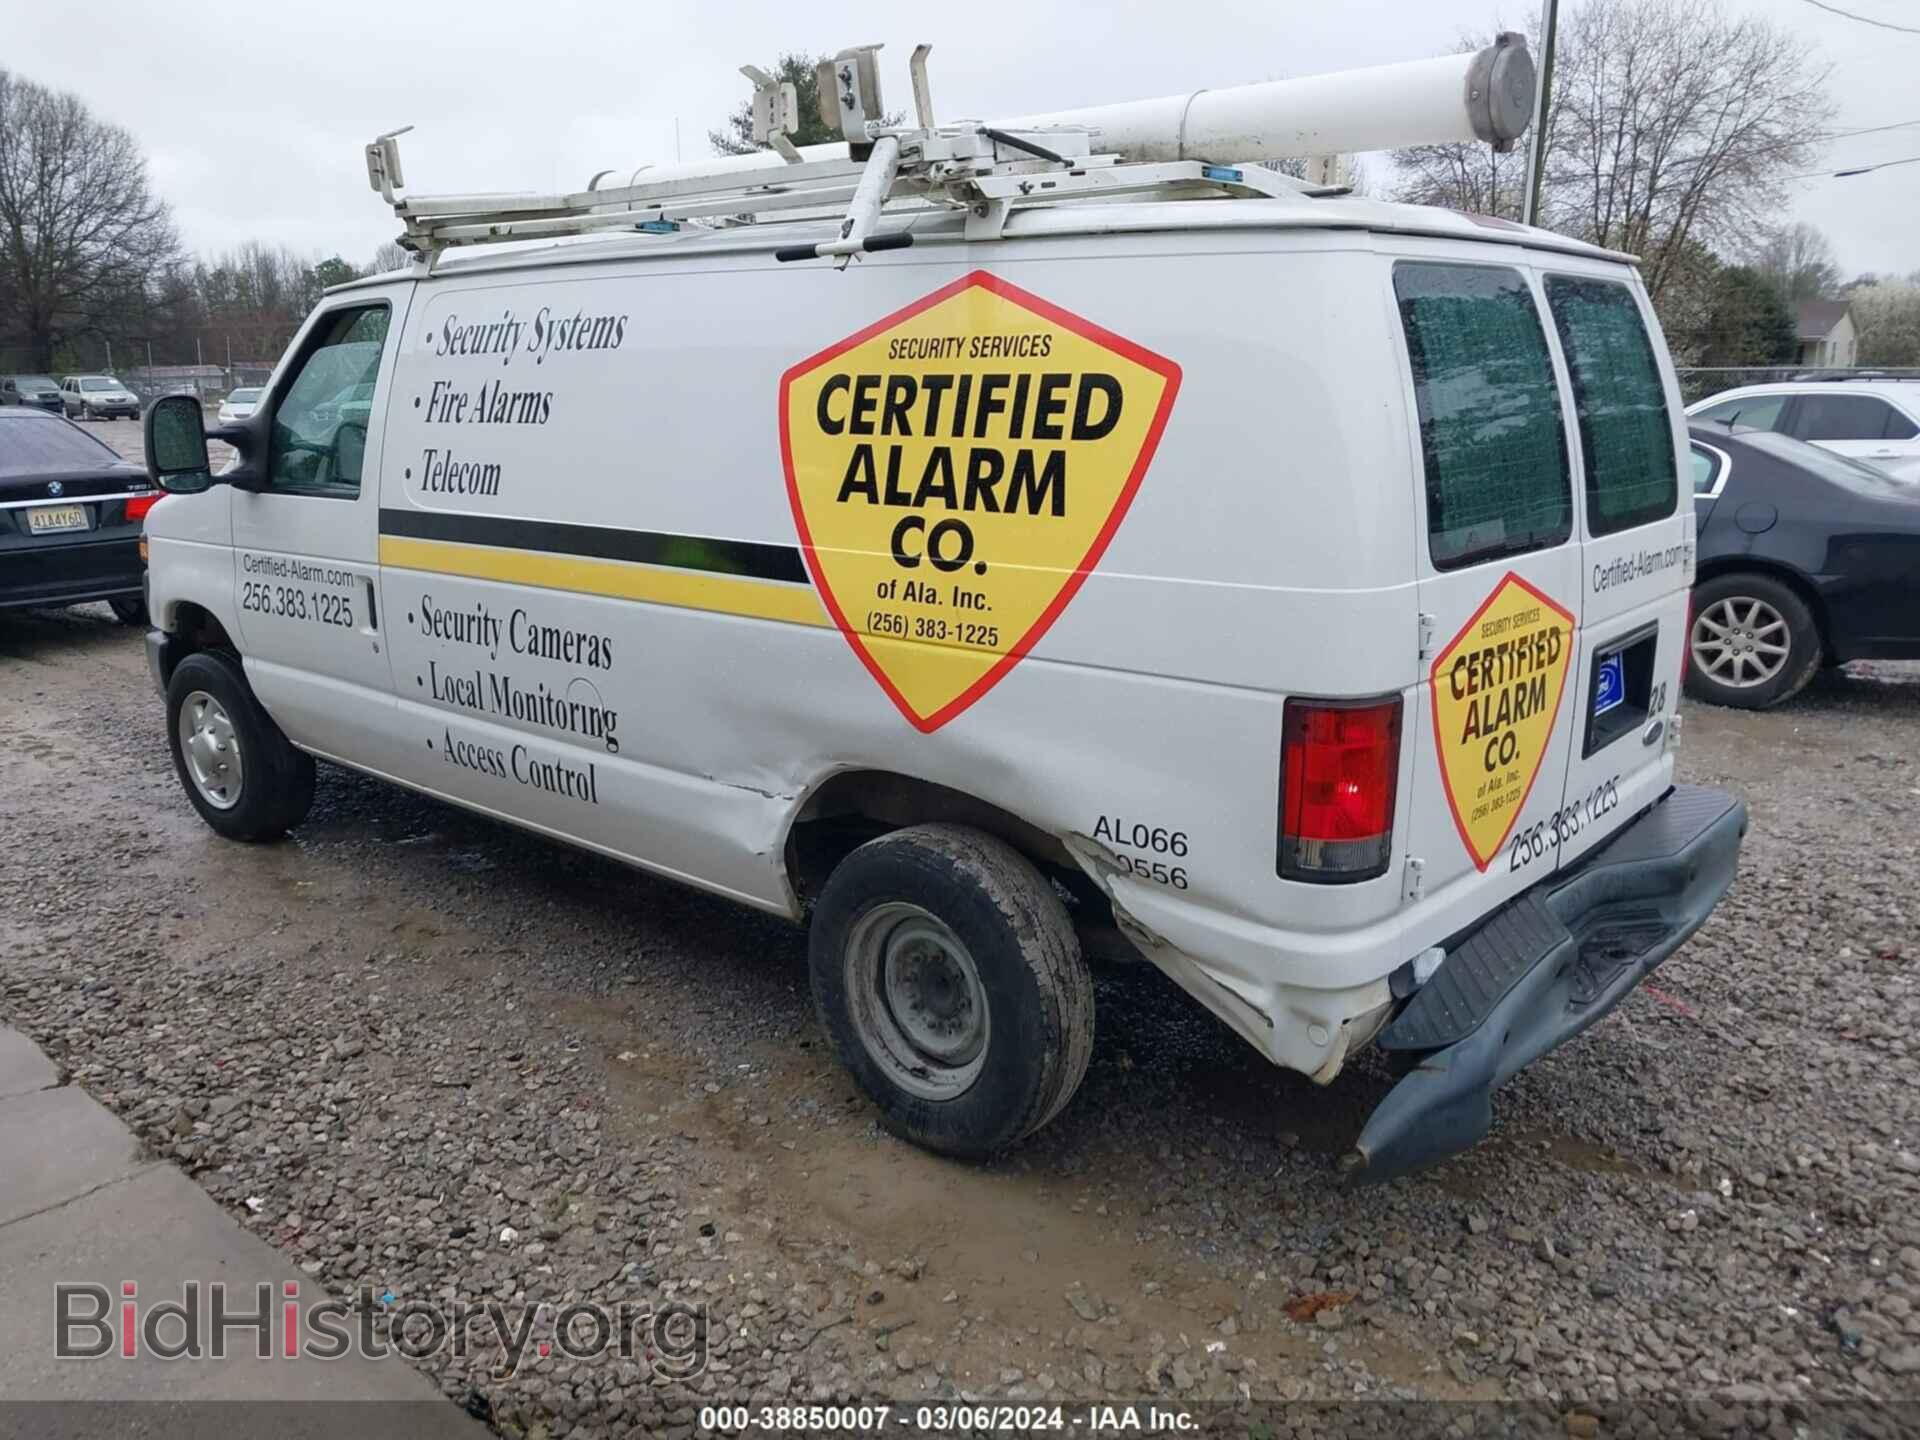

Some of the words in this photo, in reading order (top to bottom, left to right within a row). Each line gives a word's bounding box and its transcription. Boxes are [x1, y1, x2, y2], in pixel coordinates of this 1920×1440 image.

[436, 310, 527, 366] Security
[527, 307, 628, 365] Systems
[888, 337, 966, 359] SECURITY
[969, 334, 1052, 358] SERVICES
[424, 380, 468, 423] Fire
[468, 379, 553, 424] Alarms
[817, 373, 1124, 441] CERTIFIED
[421, 448, 501, 496] Telecom
[836, 444, 1066, 517] ALARM
[243, 553, 354, 588] Certified-Alarm.com
[891, 515, 988, 576] CO.
[242, 581, 353, 628] 256.383.1225
[877, 579, 897, 600] of
[903, 580, 943, 606] Ala.
[952, 586, 993, 612] Inc.
[421, 594, 502, 661] Security
[509, 608, 613, 670] Cameras
[867, 611, 909, 640] (256)
[915, 618, 999, 647] 383-1225
[1481, 616, 1512, 639] SECURITY
[1450, 626, 1561, 701] CERTIFIED
[429, 660, 484, 711] Local
[489, 672, 620, 754] Monitoring
[1461, 672, 1547, 745] ALARM
[444, 727, 507, 778] Access
[511, 744, 599, 804] Control
[1484, 730, 1520, 772] CO.
[1093, 815, 1188, 857] AL066
[1509, 774, 1620, 872] 256.383.1225
